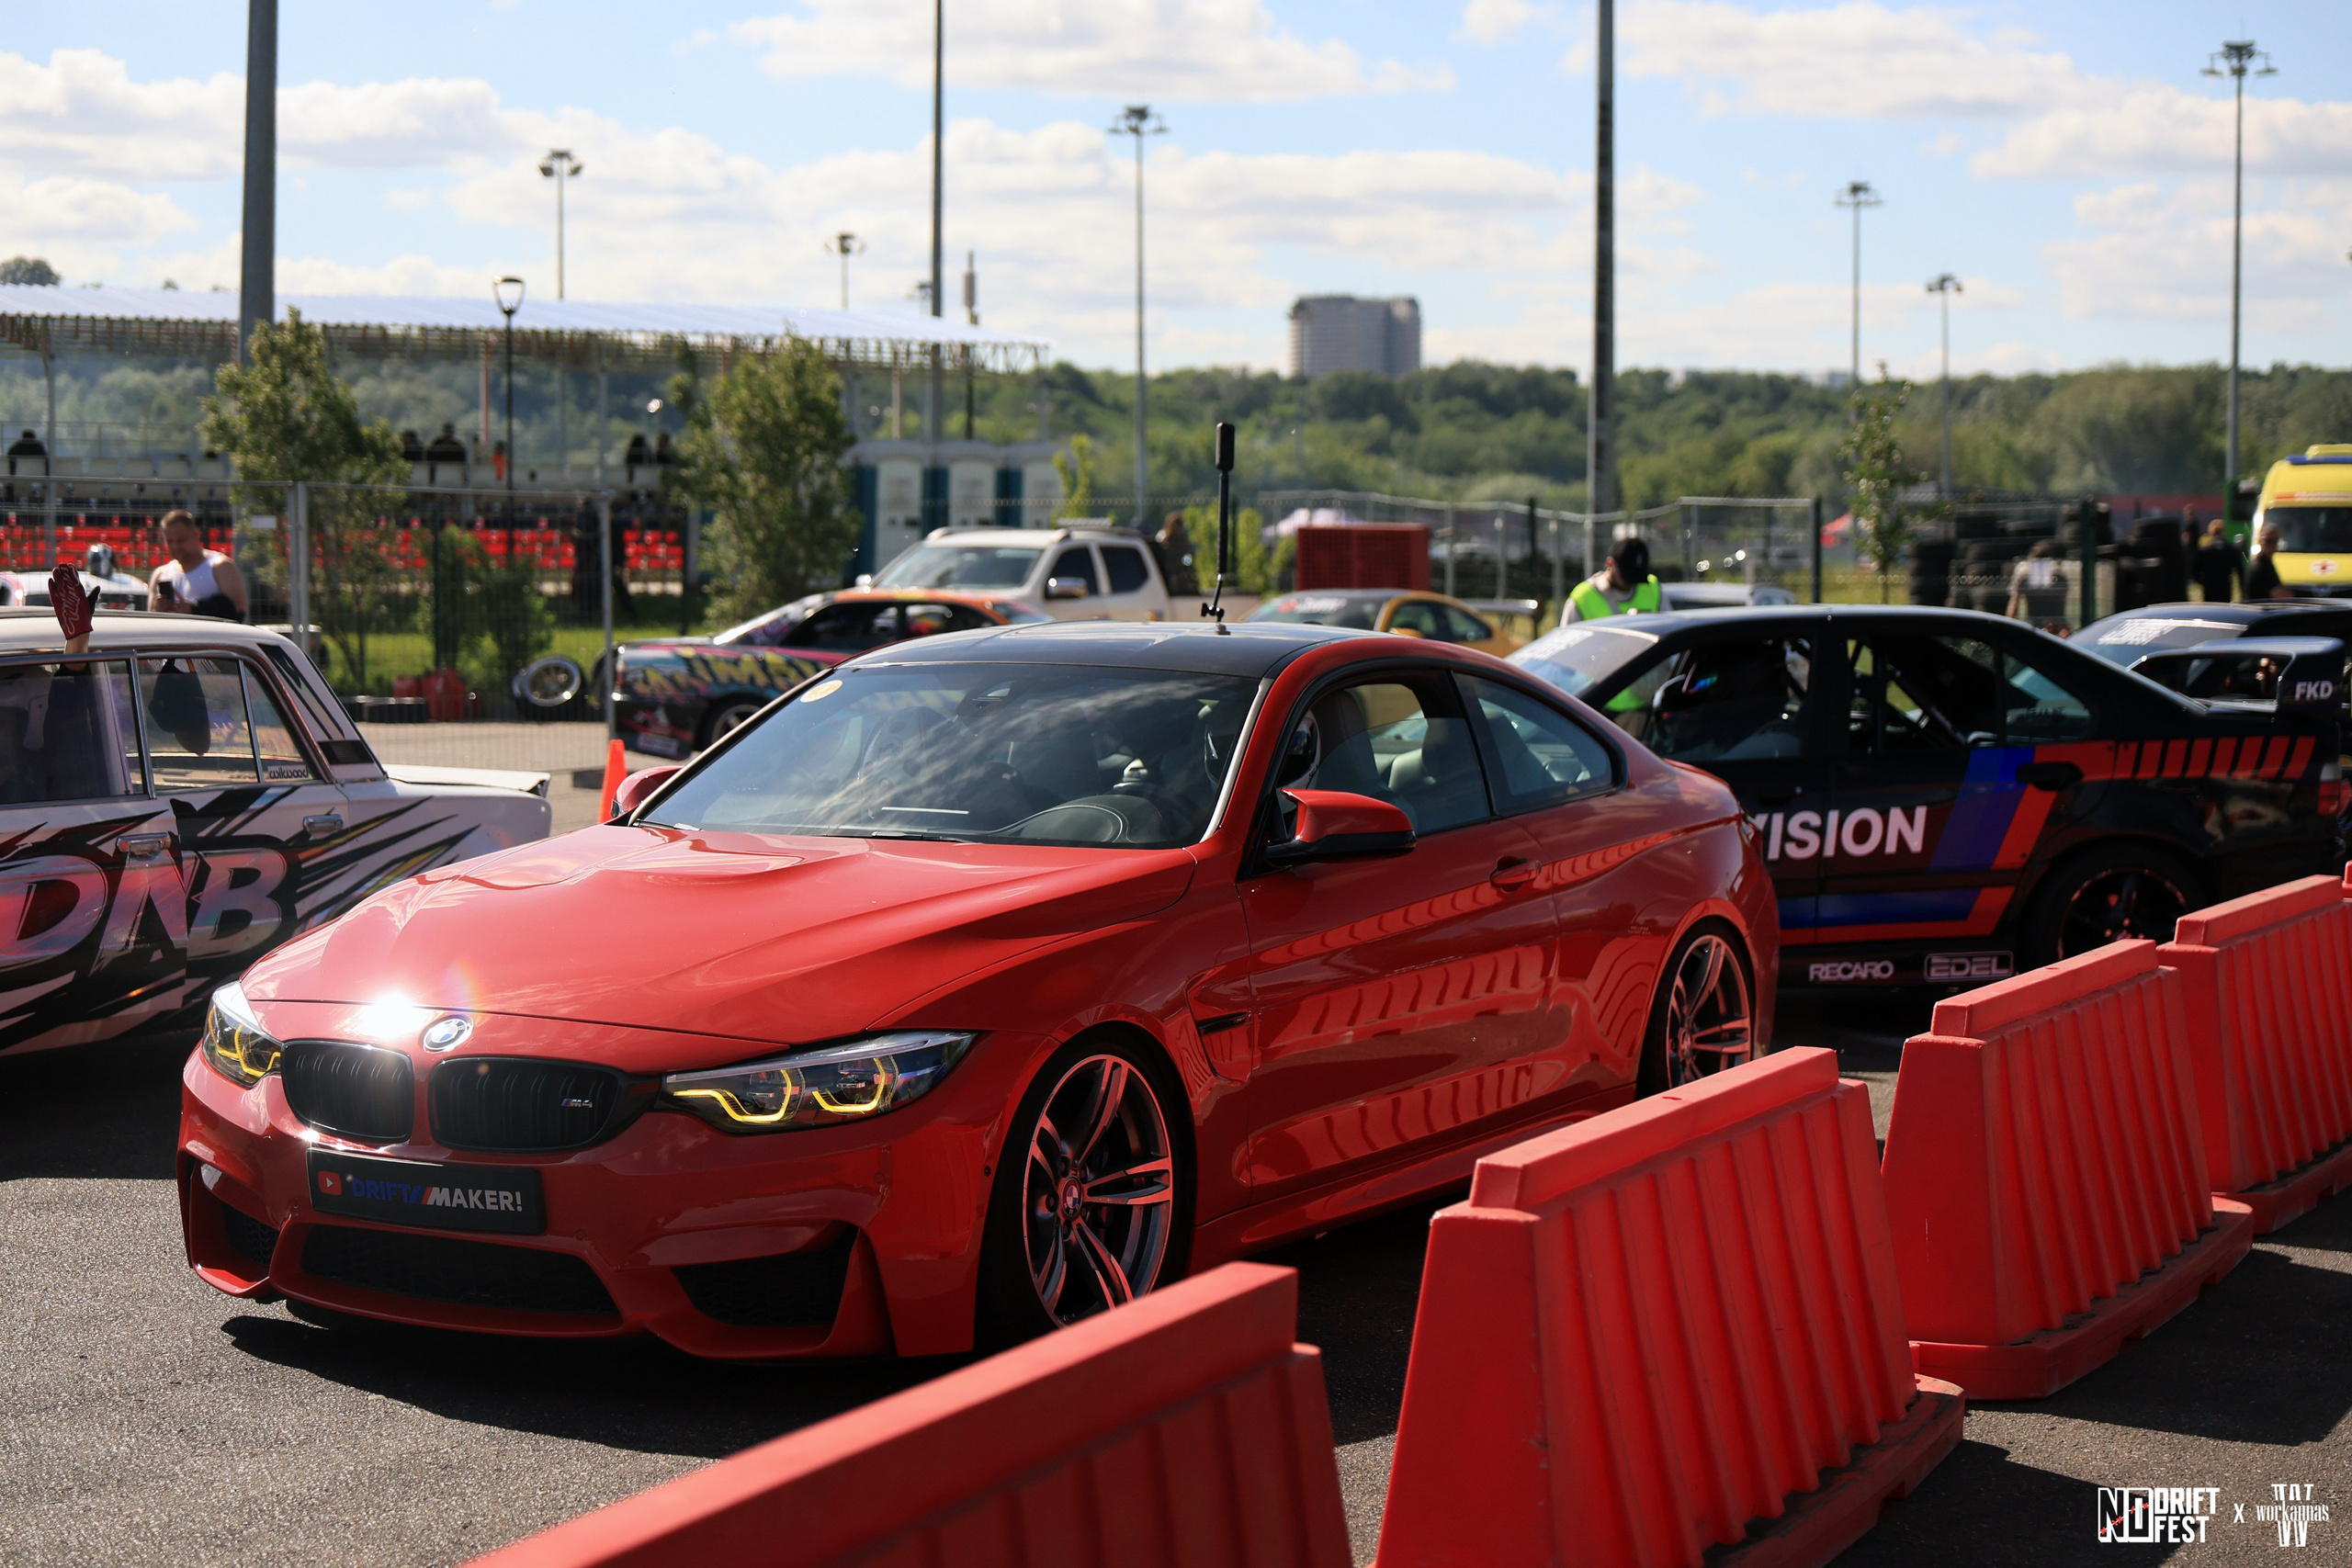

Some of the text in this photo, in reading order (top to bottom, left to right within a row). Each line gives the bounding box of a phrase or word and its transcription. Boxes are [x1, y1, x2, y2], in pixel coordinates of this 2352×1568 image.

[2294, 680, 2334, 701] FKD
[1755, 805, 1928, 861] ISION
[1808, 960, 1894, 983] RECARO
[1929, 955, 2010, 978] EDEL
